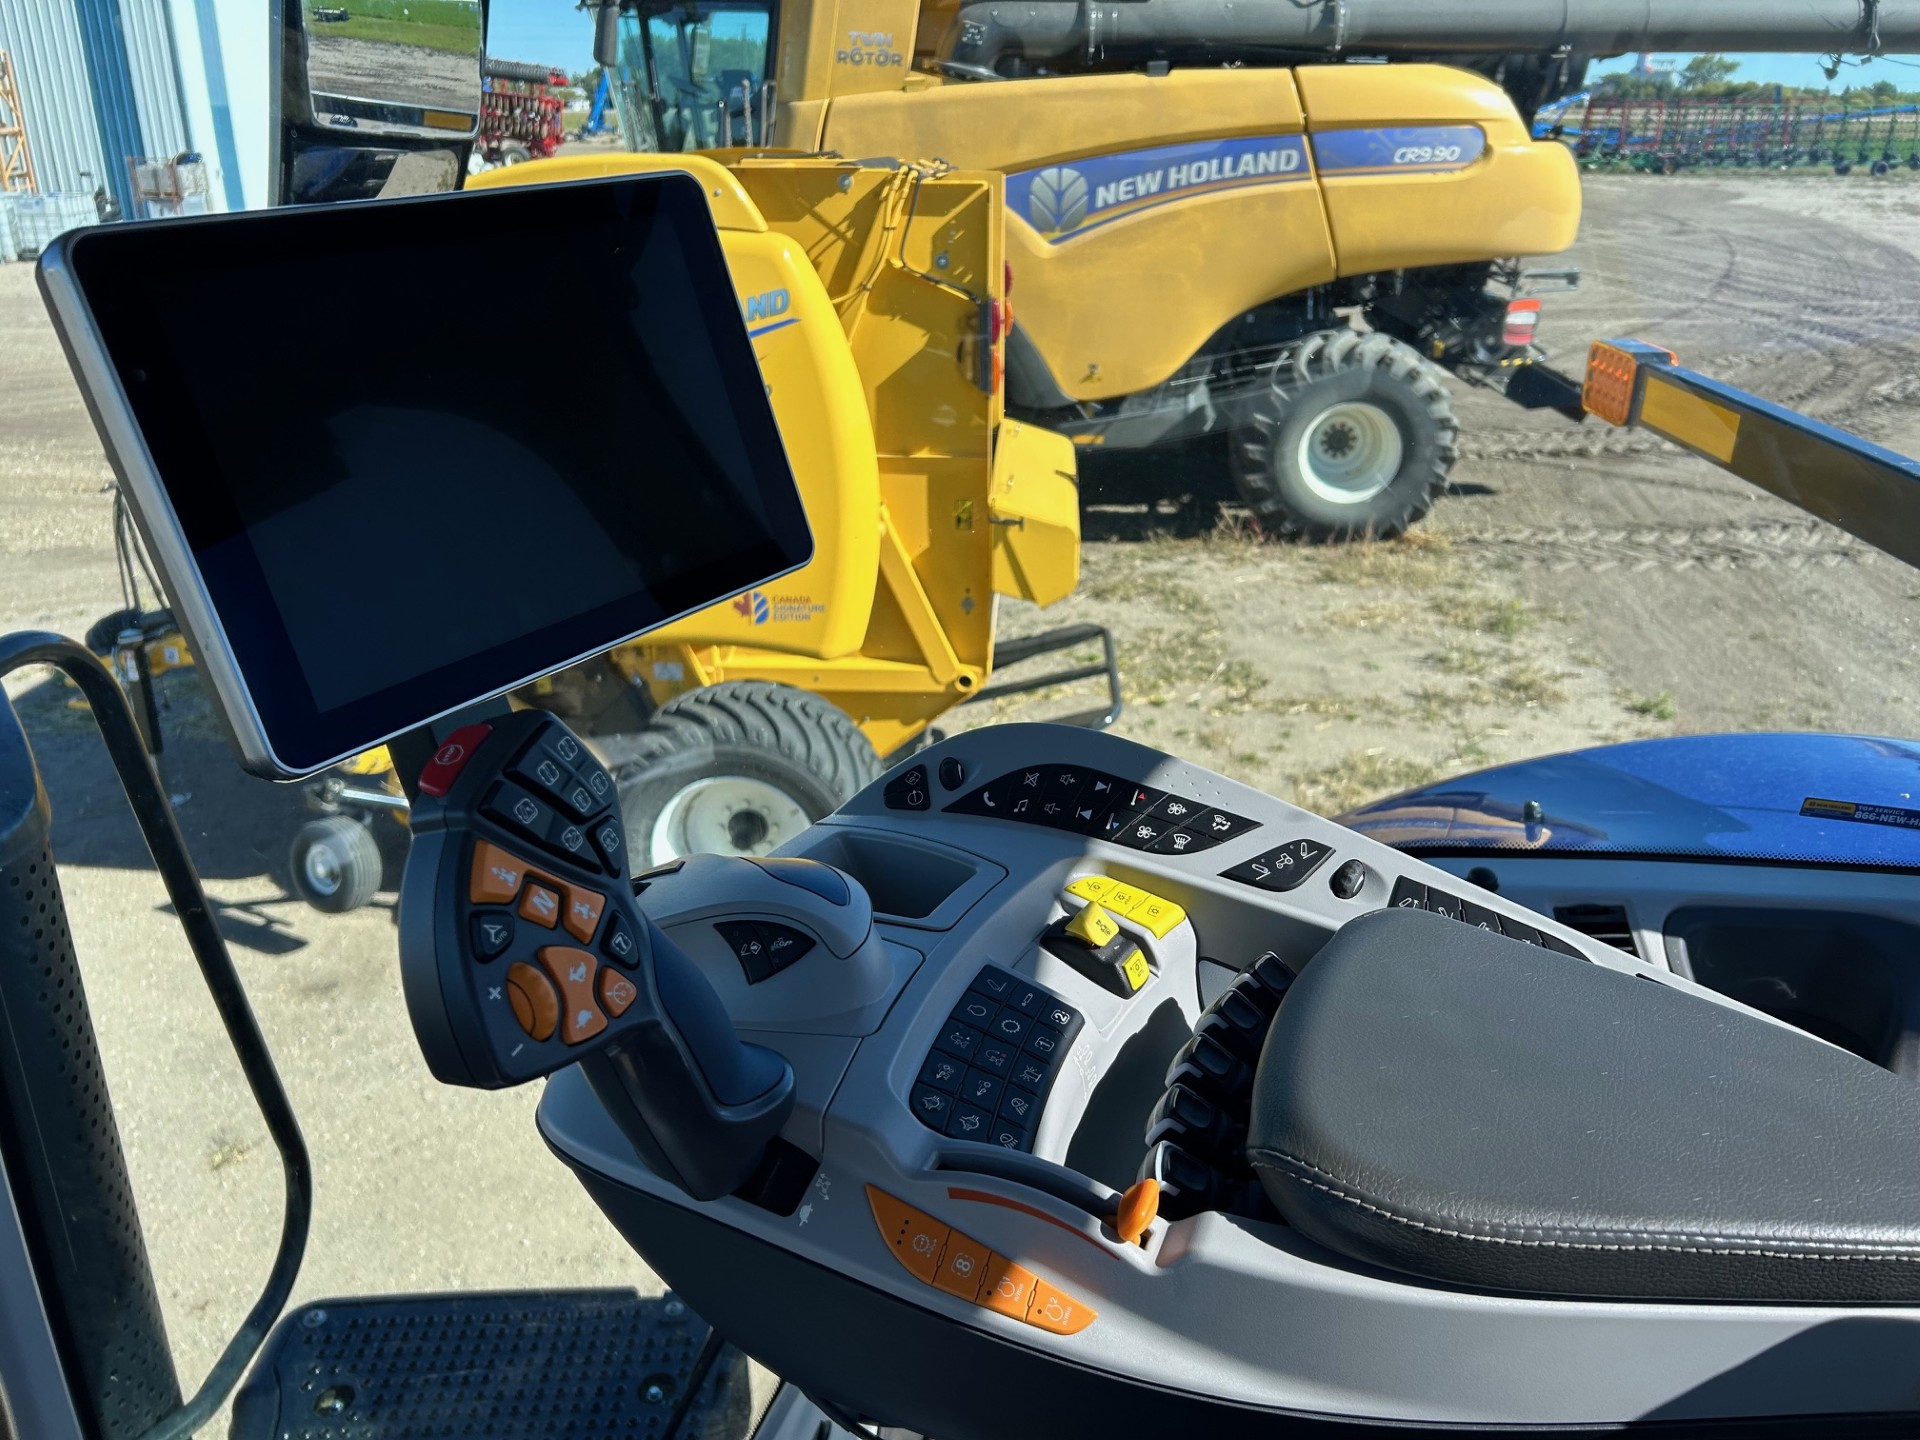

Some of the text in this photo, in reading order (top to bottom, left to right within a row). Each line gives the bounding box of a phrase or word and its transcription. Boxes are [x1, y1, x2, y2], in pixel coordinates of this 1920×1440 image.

[848, 31, 893, 48] TWIN
[837, 47, 903, 66] ROTOR
[1095, 149, 1300, 208] NEW HOLLAND
[773, 595, 812, 604] CANADA
[1854, 811, 1920, 826] 866-NEW-H
[1875, 807, 1905, 816] SERVICE
[531, 888, 555, 915] N
[495, 930, 508, 945] AUTO
[615, 936, 627, 950] 7
[1055, 1012, 1067, 1022] 2
[956, 1259, 970, 1272] 8
